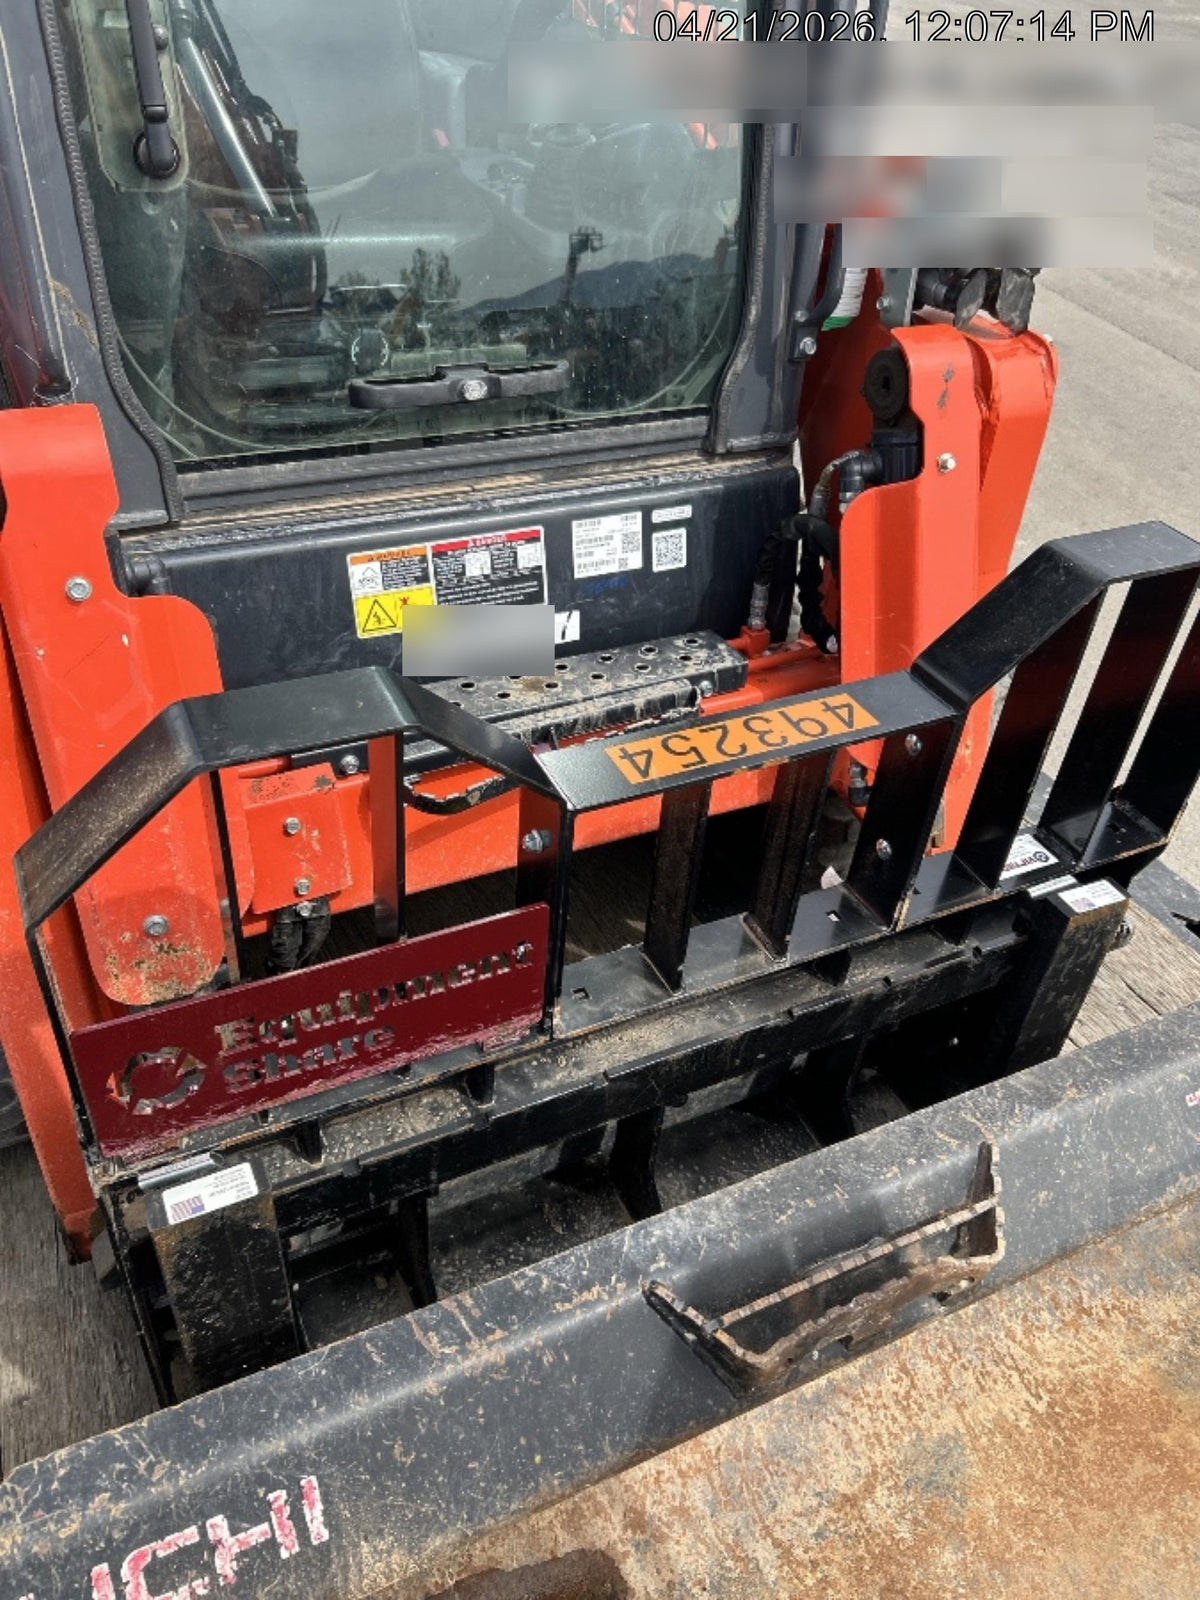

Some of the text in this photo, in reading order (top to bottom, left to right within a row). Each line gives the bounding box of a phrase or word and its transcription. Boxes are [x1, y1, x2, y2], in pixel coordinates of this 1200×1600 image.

[618, 699, 856, 780] 493254
[214, 939, 534, 1057] Equipment
[221, 1024, 396, 1094] Share
